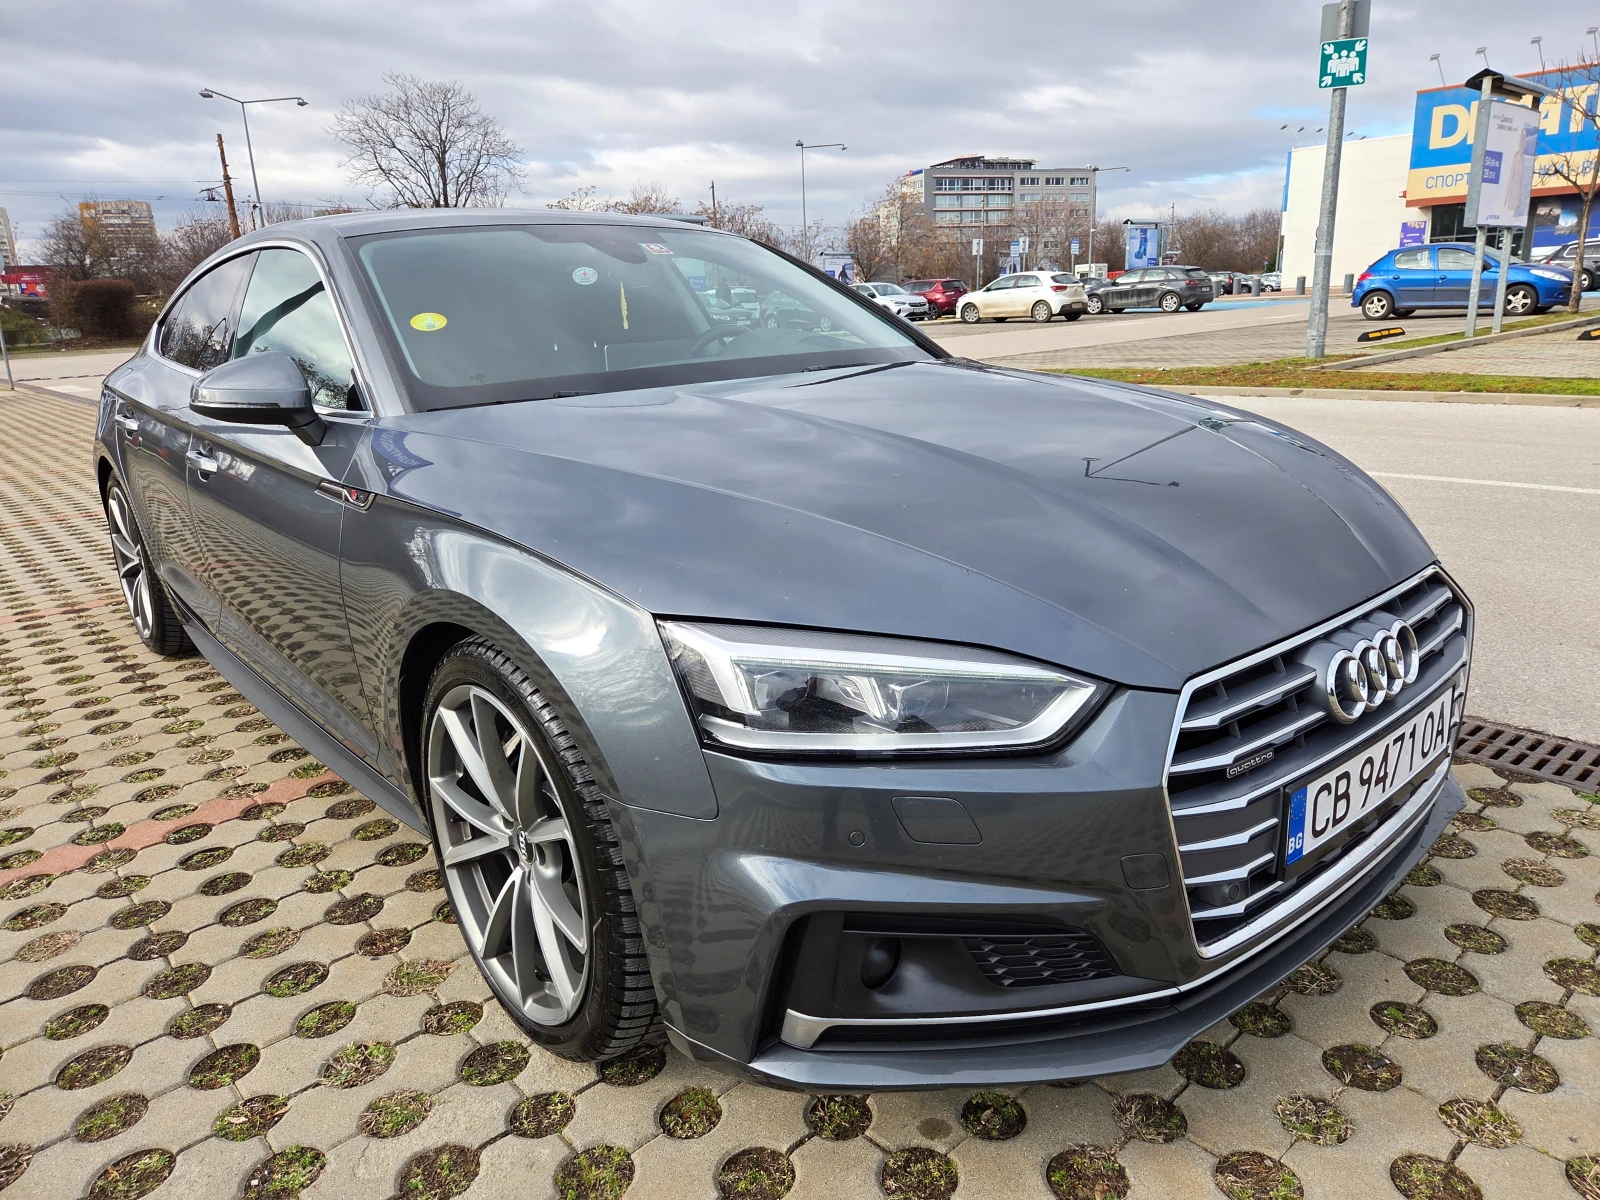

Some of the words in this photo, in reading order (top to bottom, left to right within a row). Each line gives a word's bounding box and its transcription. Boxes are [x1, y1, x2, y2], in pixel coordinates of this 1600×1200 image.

[1229, 751, 1273, 775] quattro
[1311, 770, 1351, 838] CB
[1359, 722, 1417, 809] 9471
[1421, 700, 1445, 759] OA
[1288, 832, 1303, 855] BG
